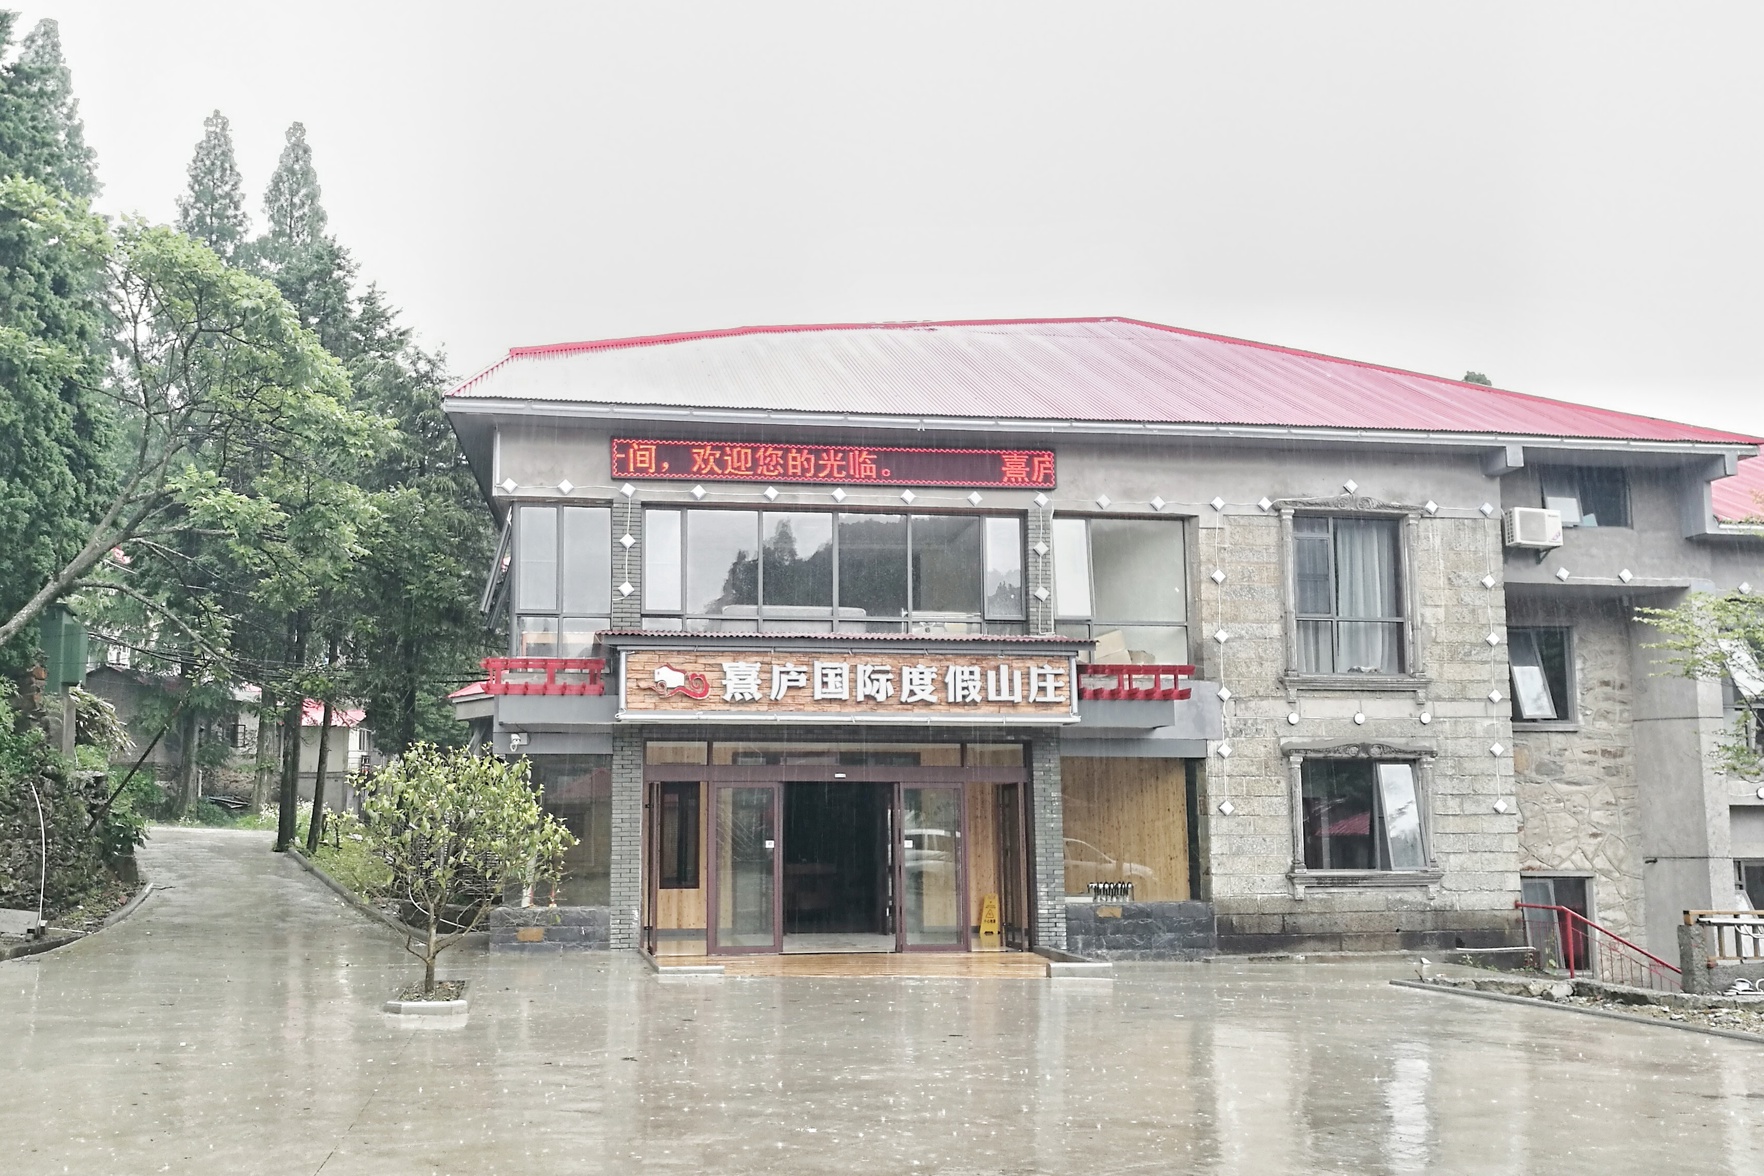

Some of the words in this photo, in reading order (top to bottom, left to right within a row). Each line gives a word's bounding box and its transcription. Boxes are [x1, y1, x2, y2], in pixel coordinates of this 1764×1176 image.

[721, 660, 1067, 703] 熹庐国际度假山庄
